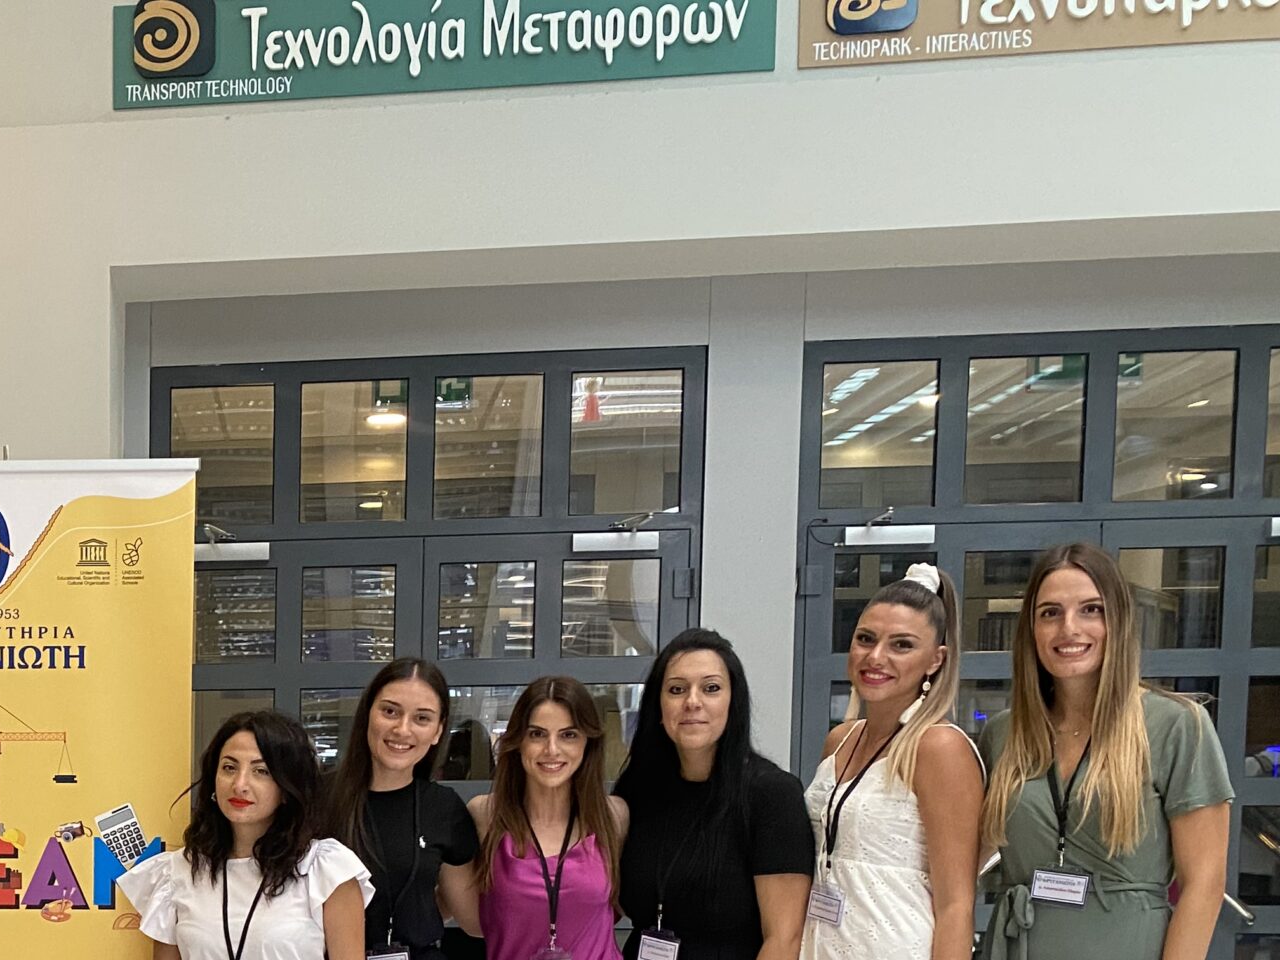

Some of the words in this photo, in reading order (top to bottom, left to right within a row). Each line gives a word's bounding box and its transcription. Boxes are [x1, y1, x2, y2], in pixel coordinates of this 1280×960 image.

[240, 0, 466, 77] Τεχνολογία
[812, 36, 912, 61] TECHNOPARK
[926, 29, 1033, 54] INTERACTIVES
[125, 81, 203, 102] TRANSPORT
[205, 76, 293, 98] TECHNOLOGY
